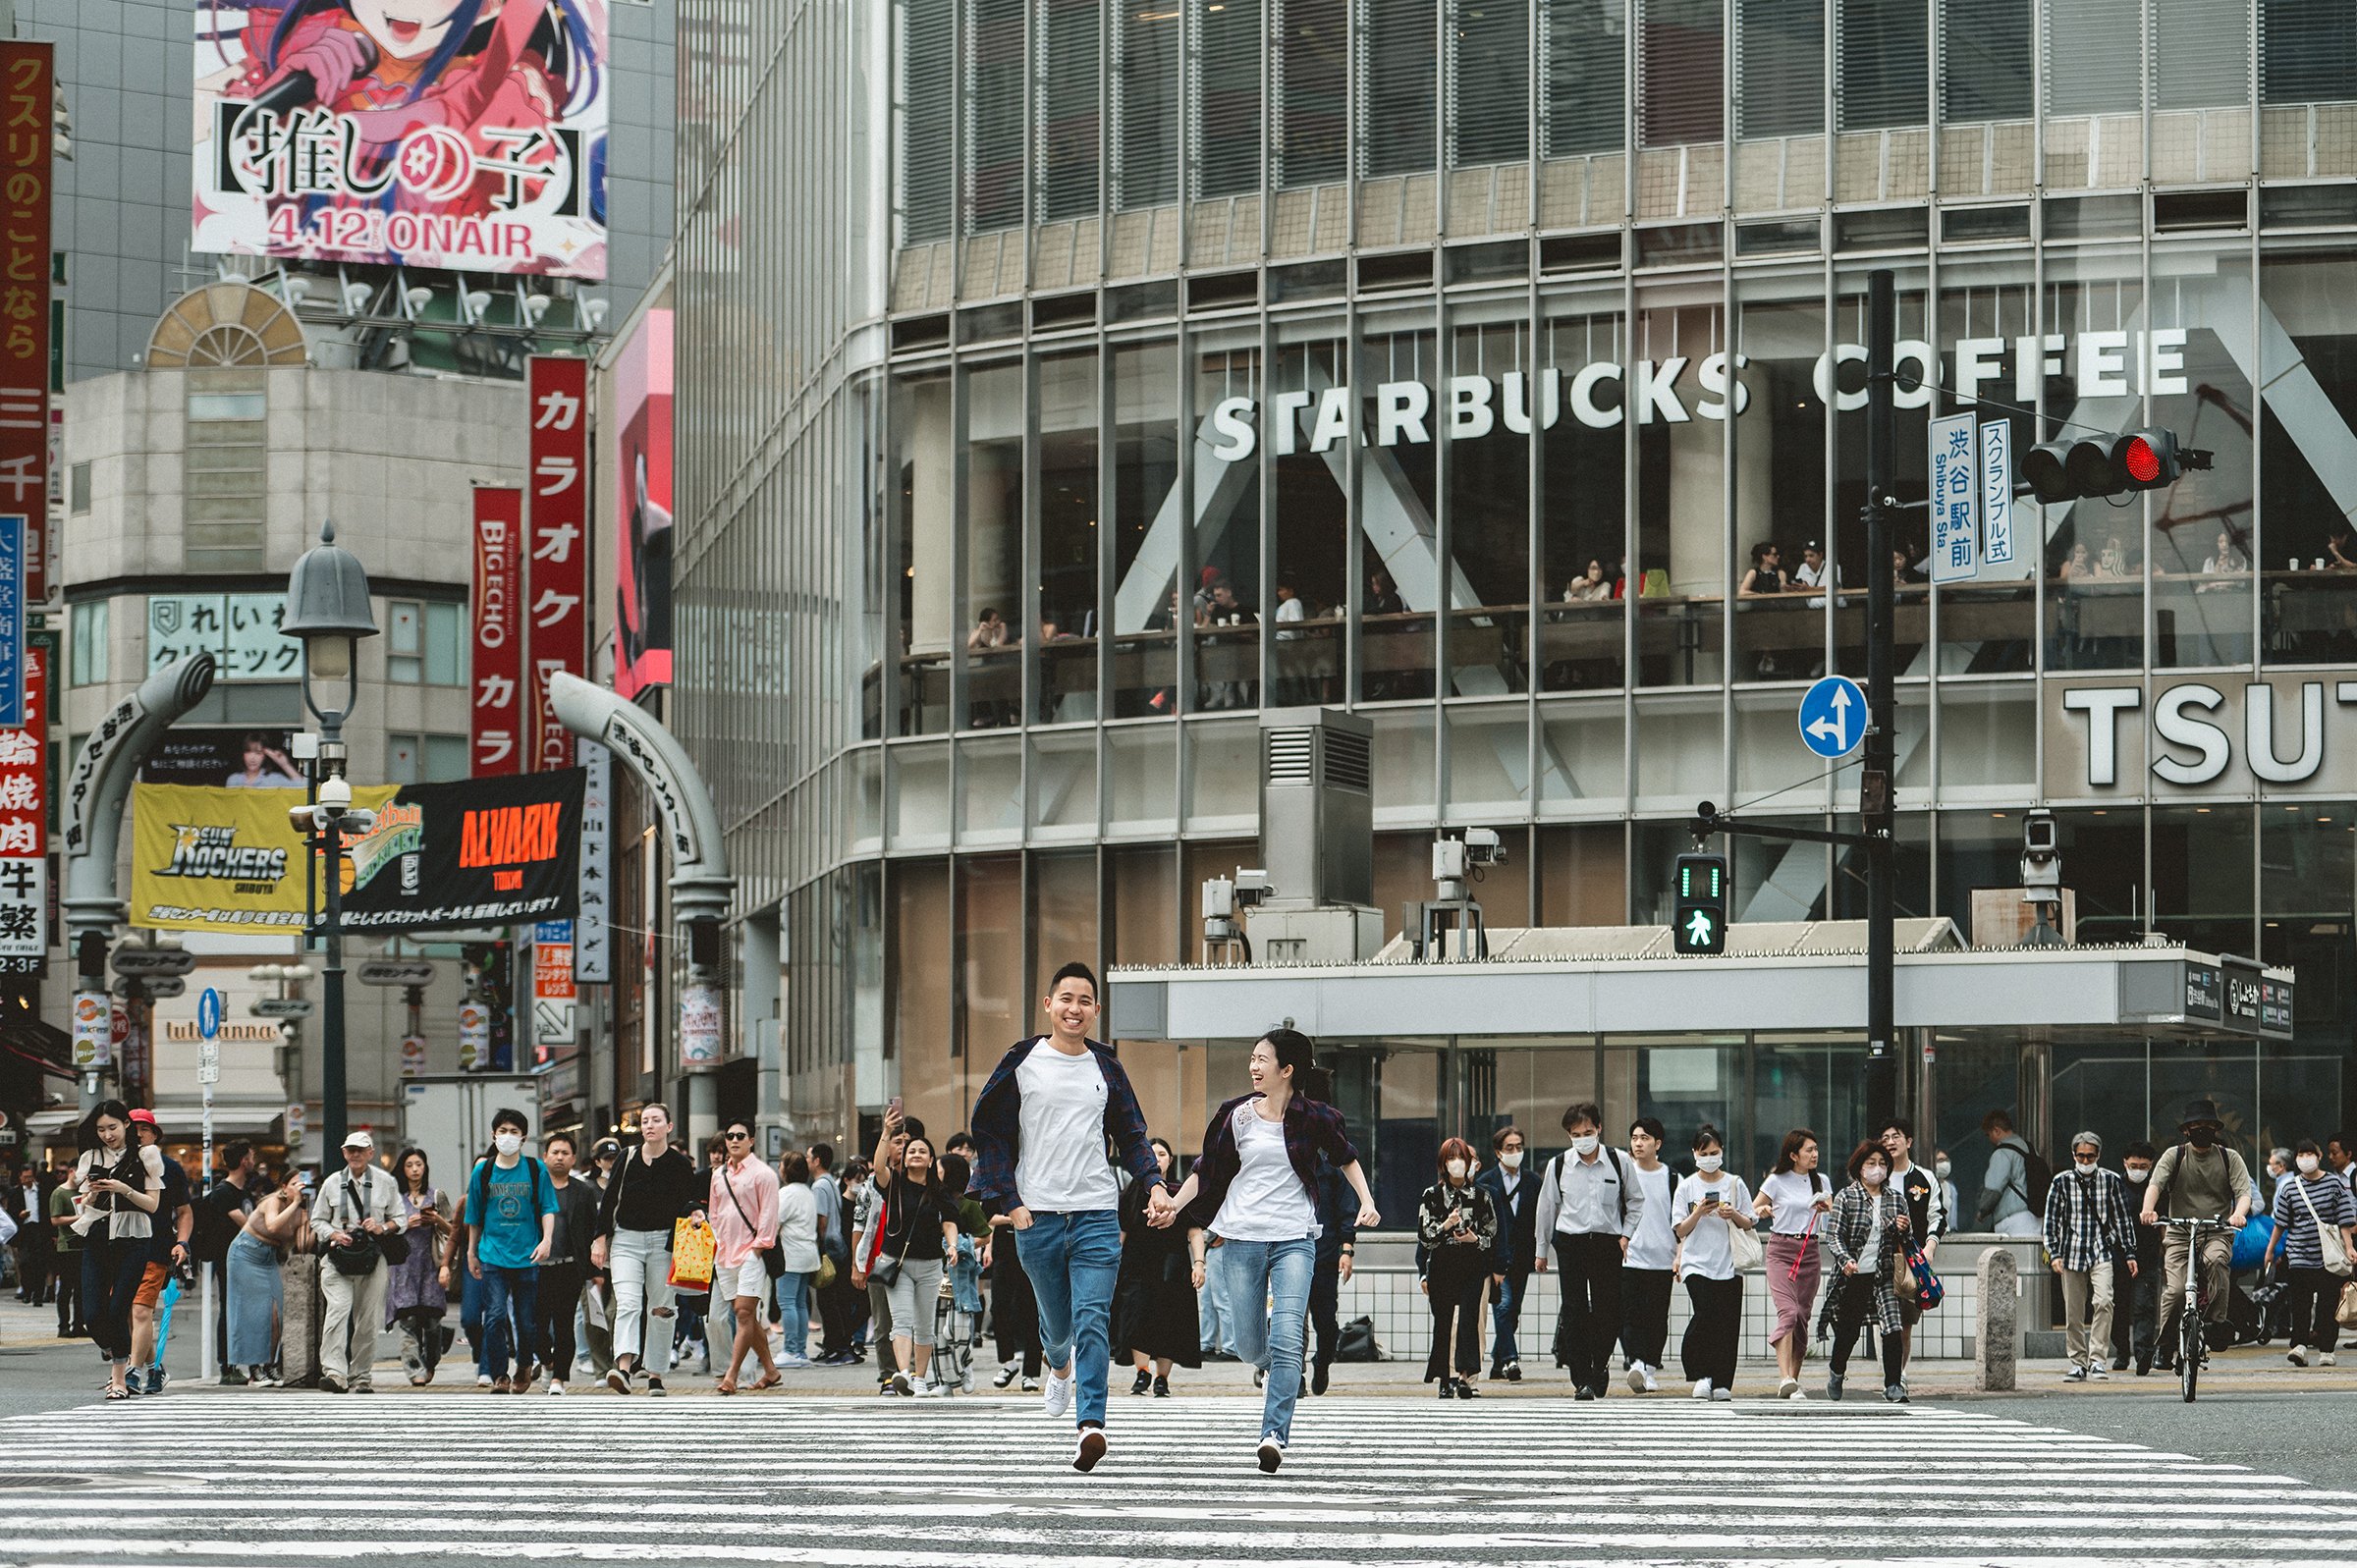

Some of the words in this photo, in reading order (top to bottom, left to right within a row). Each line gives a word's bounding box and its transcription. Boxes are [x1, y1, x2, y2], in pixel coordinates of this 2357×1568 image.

[5, 58, 42, 358] クスリのことなら
[269, 208, 368, 246] 4.12
[1212, 351, 1749, 462] STARBUCKS
[1813, 328, 2188, 411] COFFEE
[533, 391, 580, 628] カラオケ
[1935, 453, 1947, 516] Shibuya
[1948, 428, 1971, 568] 渋谷駅前
[1988, 428, 2007, 559] スクランブル式
[479, 520, 507, 572] BIG
[1936, 521, 1948, 554] Sta.
[479, 576, 506, 649] ECHO
[477, 675, 516, 765] カラ
[66, 701, 135, 850] 渋谷センター街
[614, 723, 690, 855] 渋谷センター街
[199, 826, 236, 846] SUN
[459, 801, 562, 869] ALVARK
[0, 861, 37, 940] 牛繁
[234, 883, 275, 894] SHIBUYA
[493, 869, 523, 892] TOKYO
